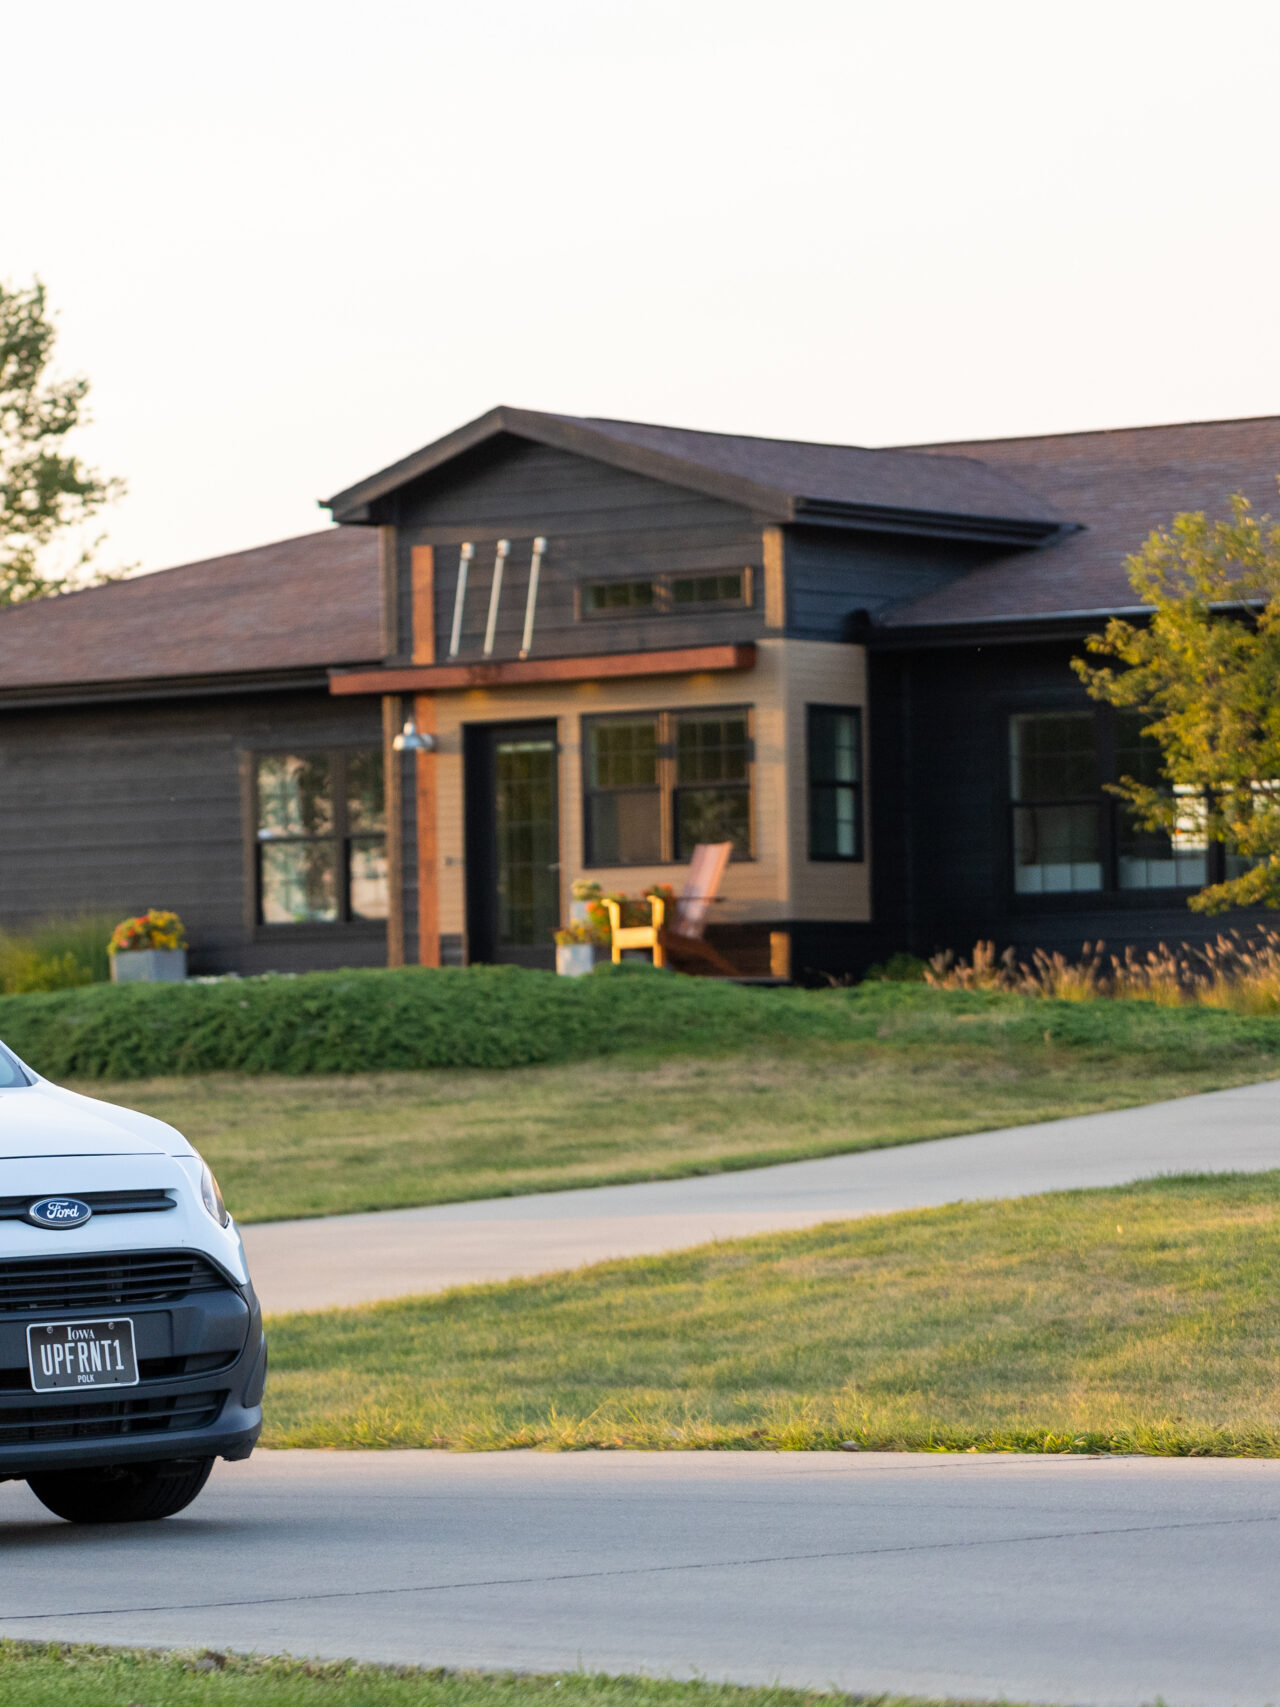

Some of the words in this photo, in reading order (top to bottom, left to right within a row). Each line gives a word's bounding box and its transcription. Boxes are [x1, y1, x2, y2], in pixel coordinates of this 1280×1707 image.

[46, 1201, 80, 1219] Ford
[40, 1340, 125, 1375] UPFRNT1
[77, 1374, 95, 1384] POLK
